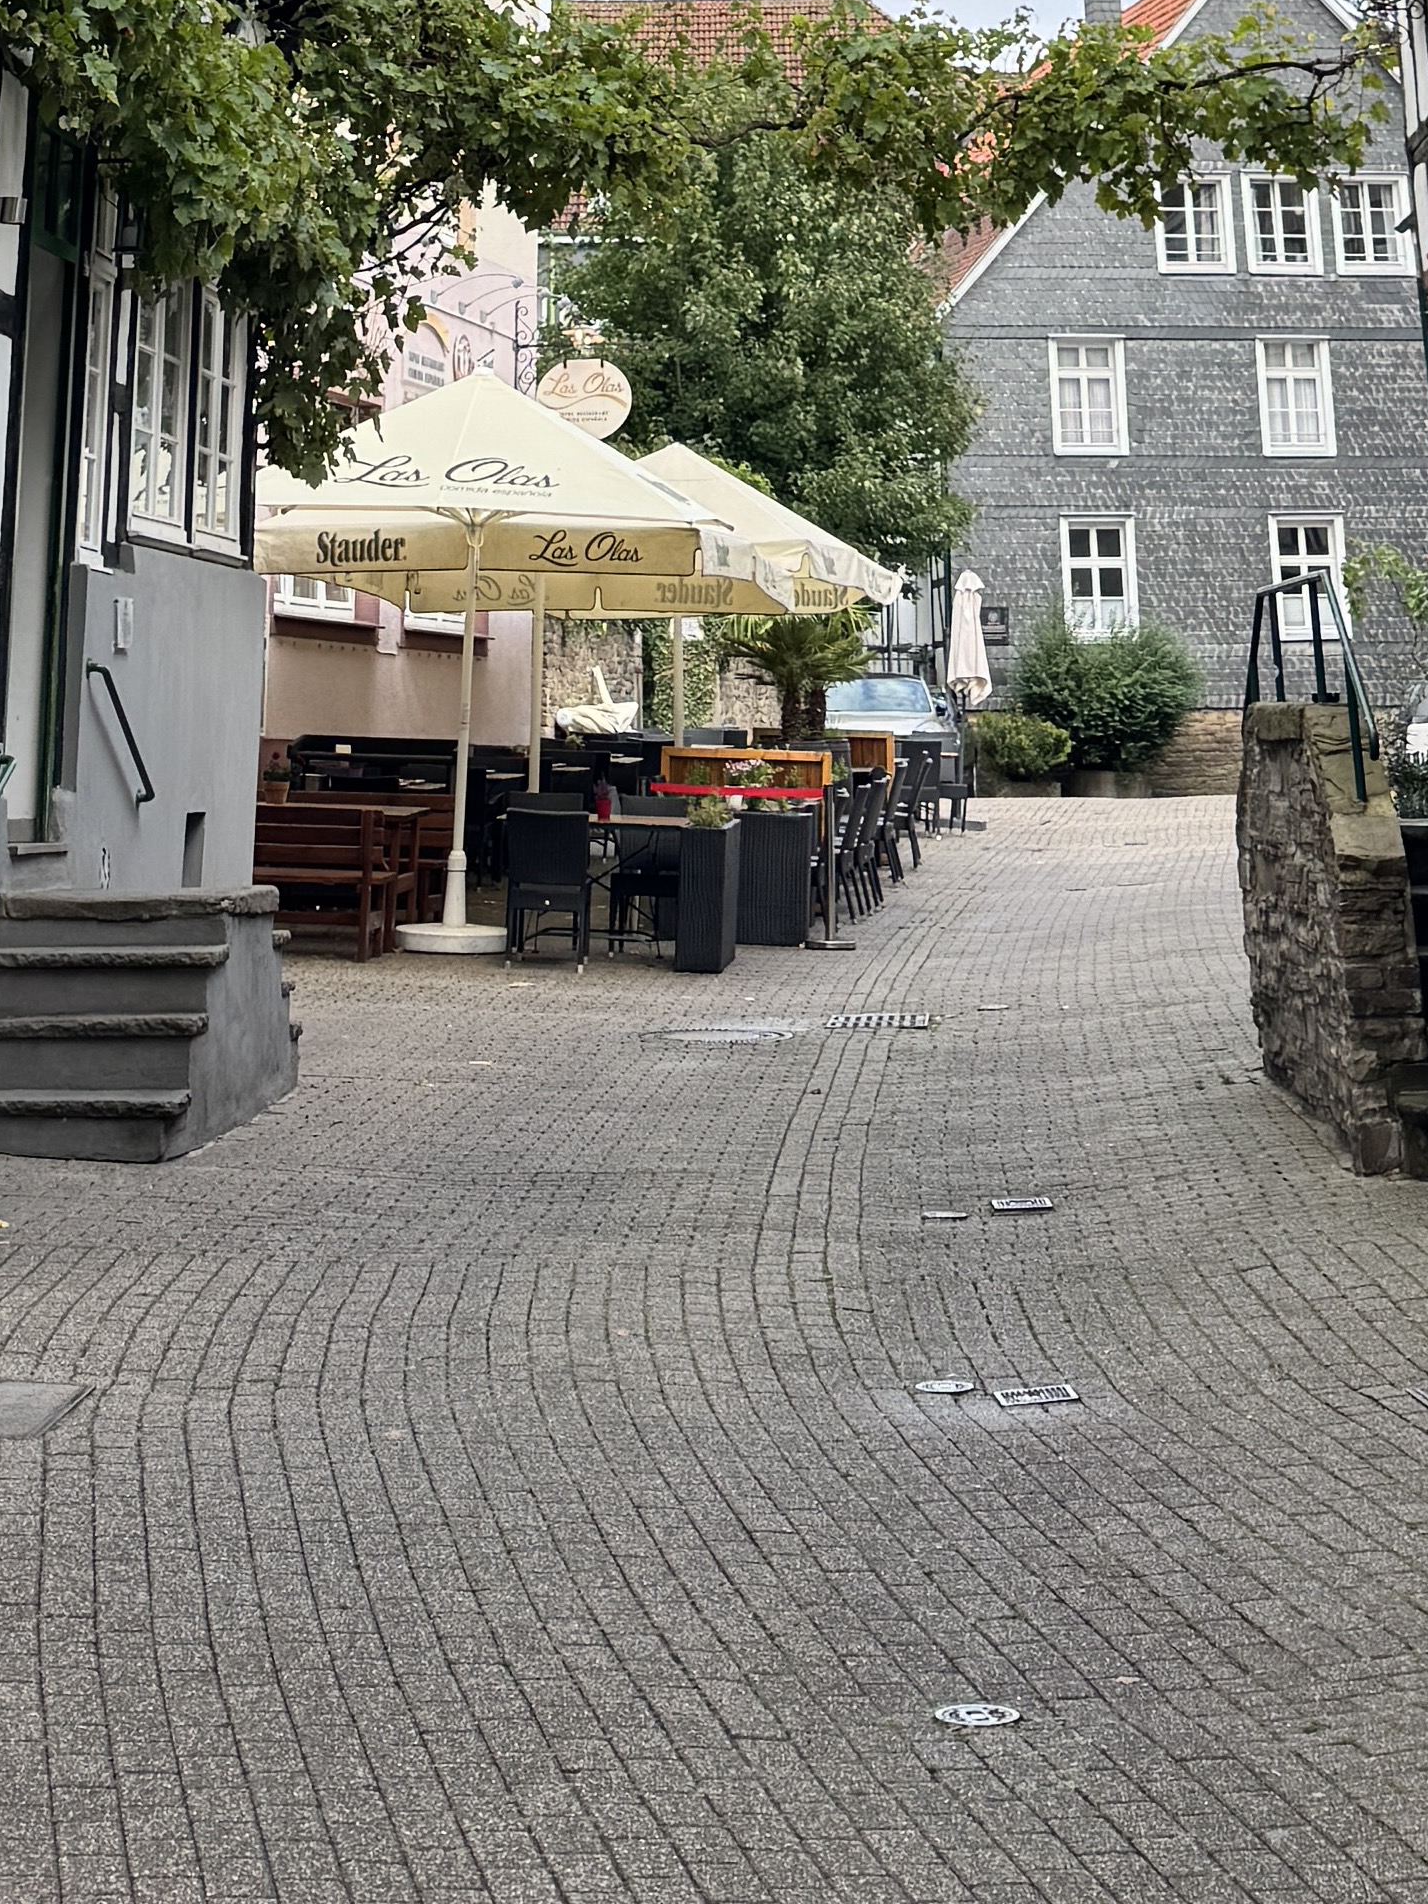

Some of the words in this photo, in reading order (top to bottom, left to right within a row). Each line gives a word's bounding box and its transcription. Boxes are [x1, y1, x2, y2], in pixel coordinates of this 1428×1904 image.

[543, 372, 578, 399] Las
[583, 371, 625, 394] Olas
[333, 454, 431, 488] Las
[444, 457, 561, 489] Olas
[528, 529, 579, 567] Las
[584, 530, 644, 563] Olas
